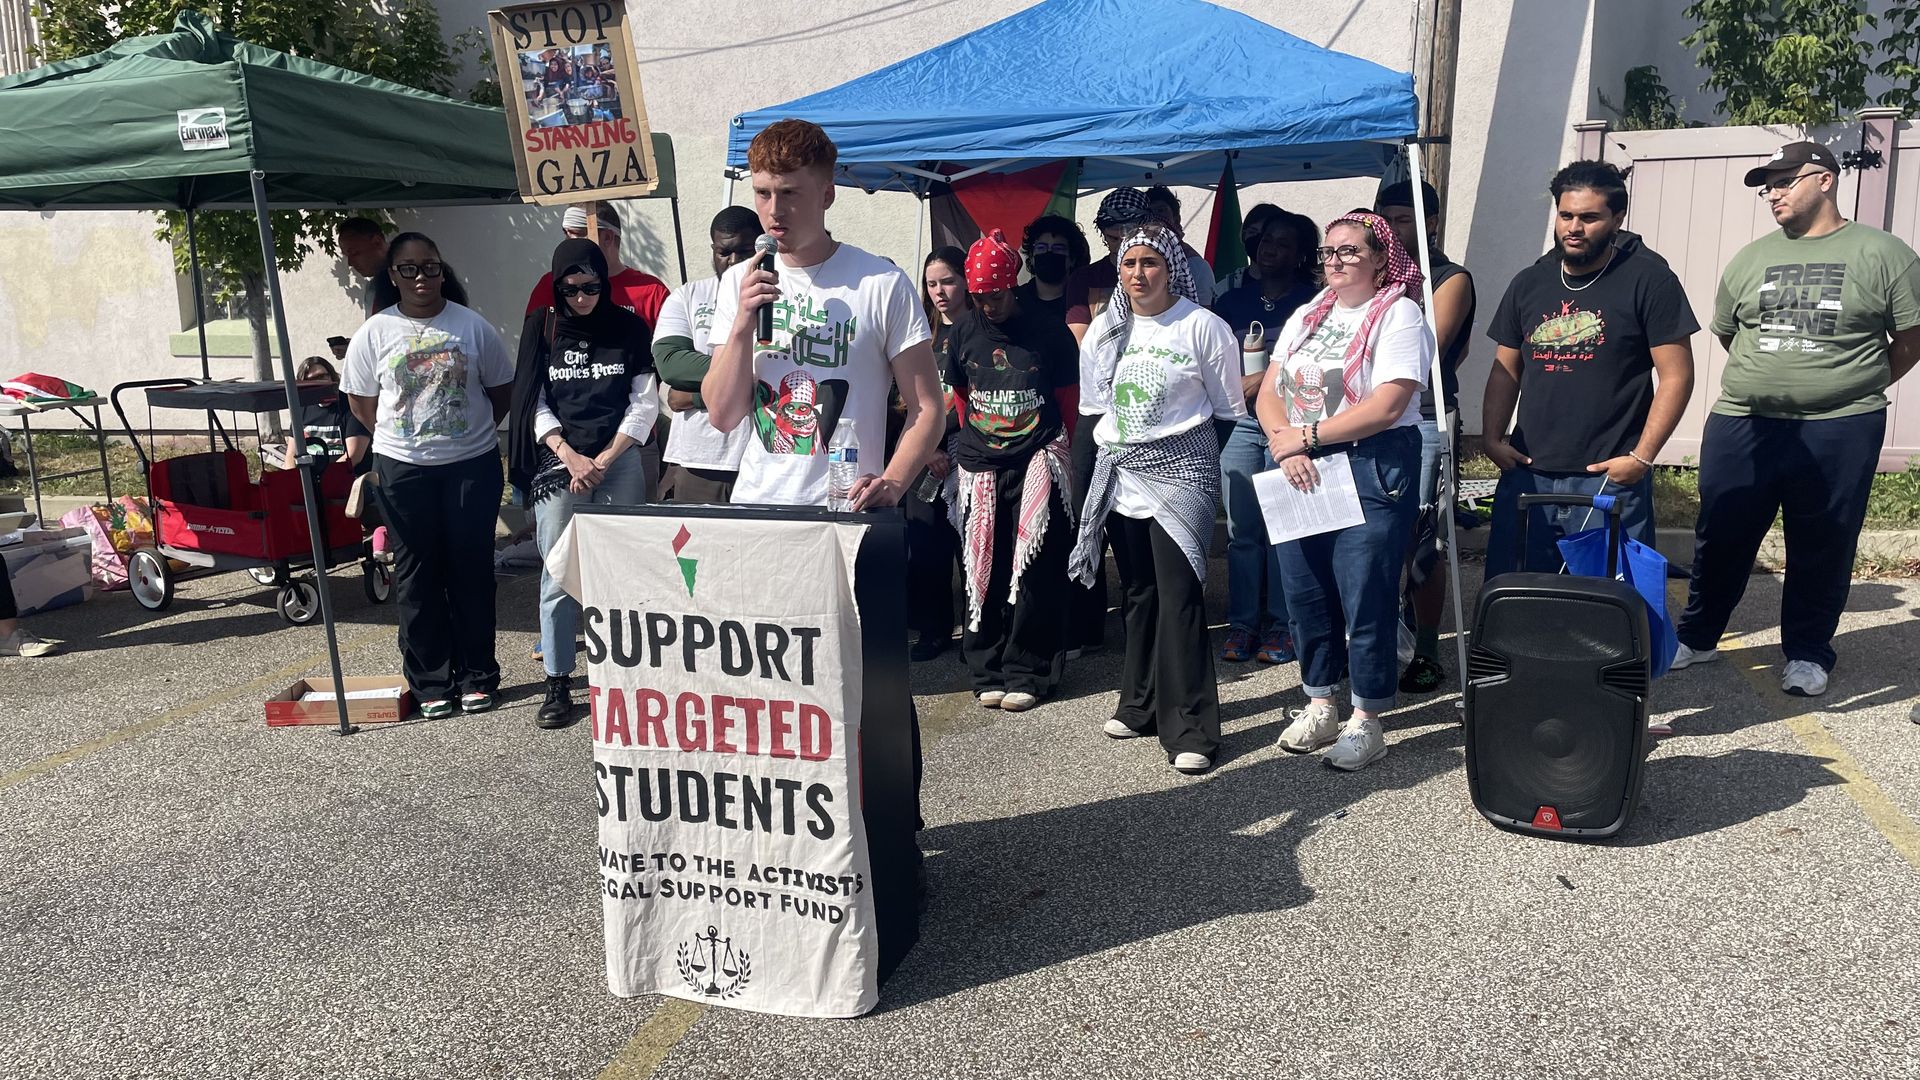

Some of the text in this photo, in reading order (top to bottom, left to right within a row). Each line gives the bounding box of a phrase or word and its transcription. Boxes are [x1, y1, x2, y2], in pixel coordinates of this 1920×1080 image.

[510, 3, 612, 50] STOP
[181, 125, 223, 140] Eurmax
[525, 118, 636, 152] STARVING
[536, 147, 652, 195] GAZA
[1764, 263, 1846, 287] FREE
[409, 351, 445, 360] STORY
[564, 350, 589, 365] The
[1148, 345, 1193, 366] الوجود
[549, 363, 625, 382] People's Press
[993, 390, 1016, 403] LIVE
[1016, 389, 1037, 402] THE
[583, 606, 821, 686] SUPPORT
[367, 712, 397, 720] STAPLES
[594, 761, 835, 841] STUDENTS
[651, 852, 687, 873] TO
[693, 854, 735, 879] THE
[747, 863, 863, 897] ACTIVISTS
[660, 878, 772, 910] SUPPORT
[781, 894, 844, 925] FUND
